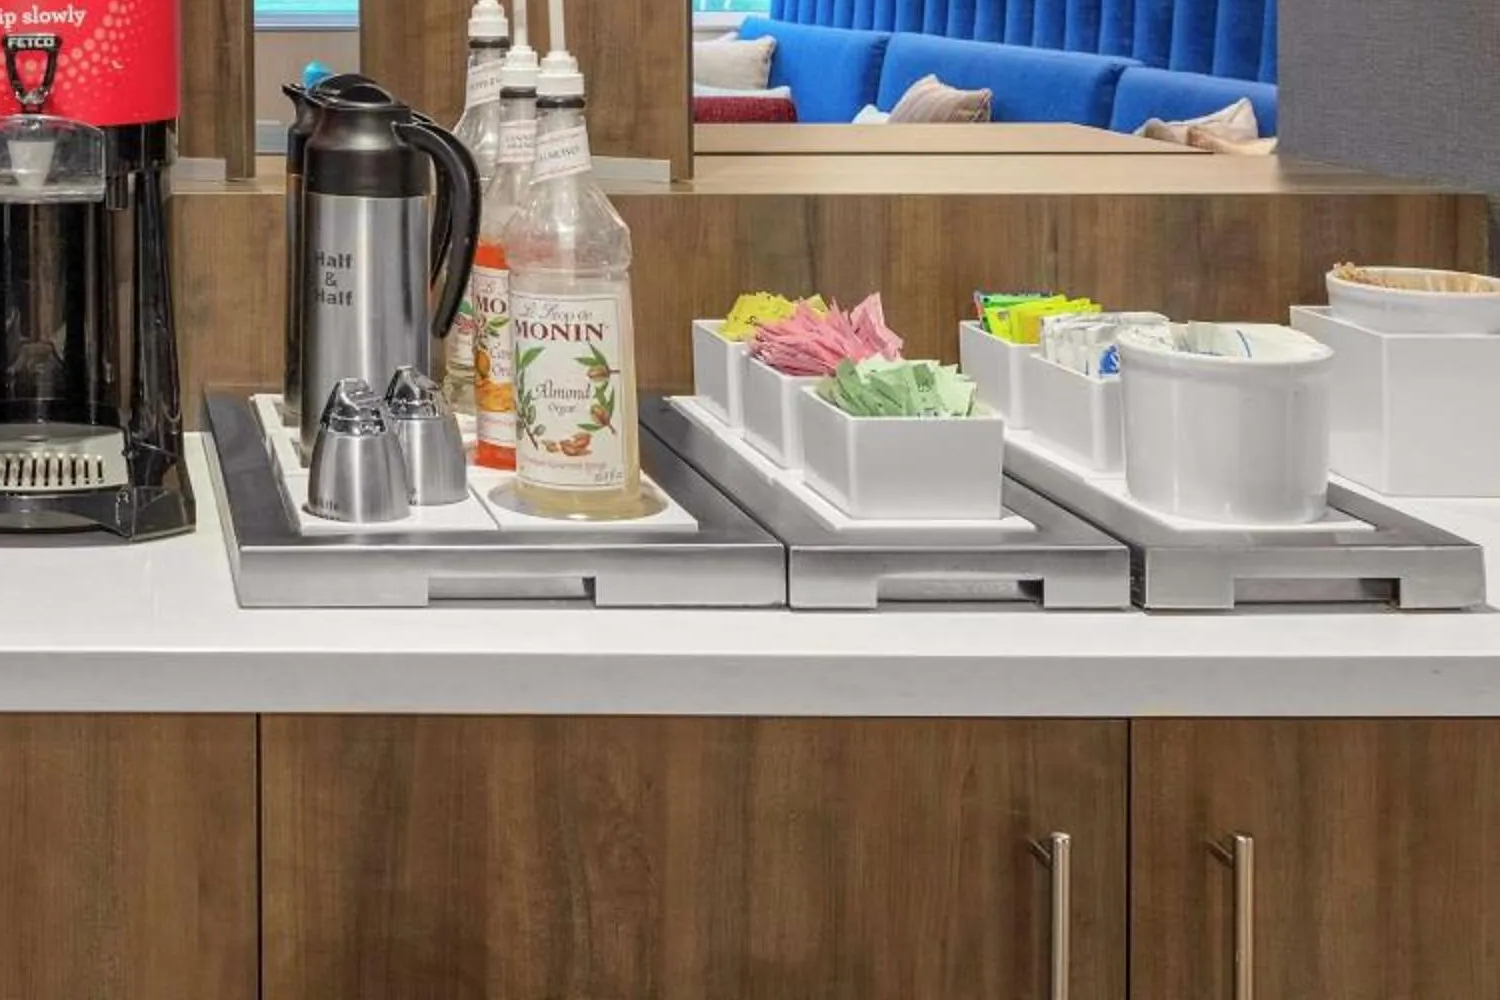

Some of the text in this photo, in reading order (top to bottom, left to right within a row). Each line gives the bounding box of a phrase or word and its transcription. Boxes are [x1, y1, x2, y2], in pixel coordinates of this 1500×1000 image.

[22, 5, 87, 27] slowly
[7, 36, 56, 49] FETCO
[325, 271, 338, 287] &
[514, 318, 605, 341] MONIN
[531, 379, 593, 401] Almond
